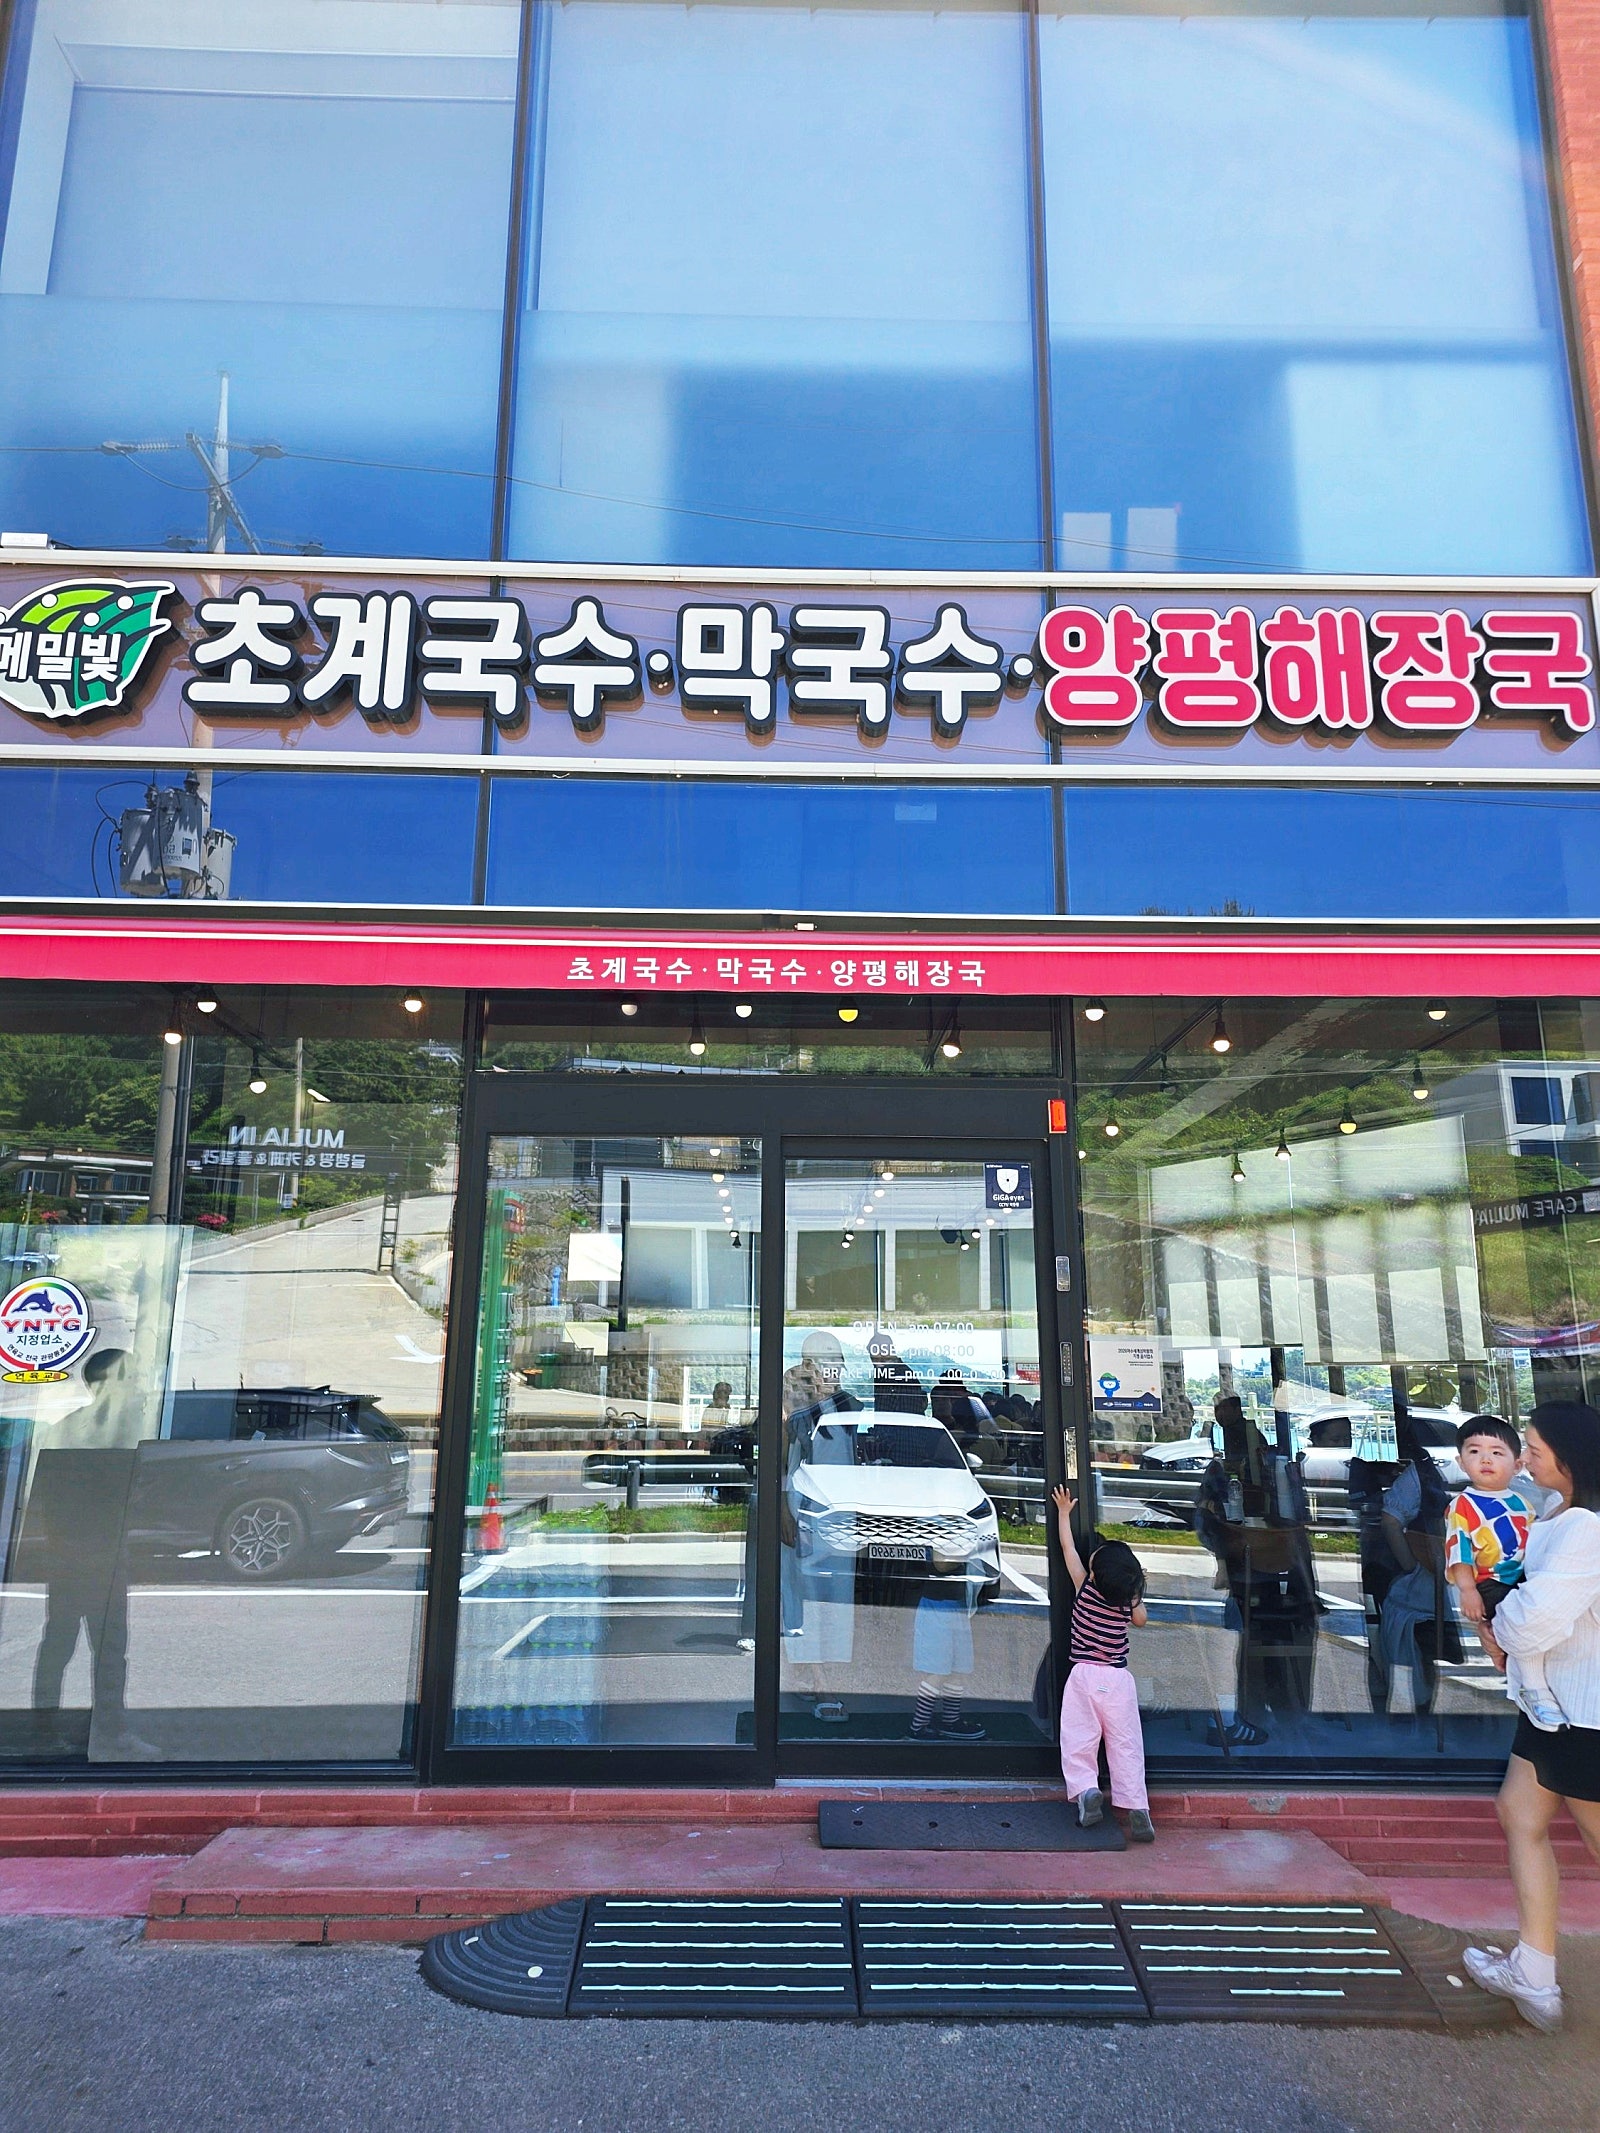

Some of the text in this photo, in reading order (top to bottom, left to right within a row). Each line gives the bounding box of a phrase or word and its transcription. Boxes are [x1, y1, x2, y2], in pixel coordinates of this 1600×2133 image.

[0, 630, 122, 681] 메밀빛
[1039, 604, 1598, 733] 양평해장국
[829, 959, 987, 987] 양평해장국
[1, 1318, 81, 1333] YNTG
[16, 1334, 63, 1346] 지정업소
[822, 1367, 864, 1379] BRAKE
